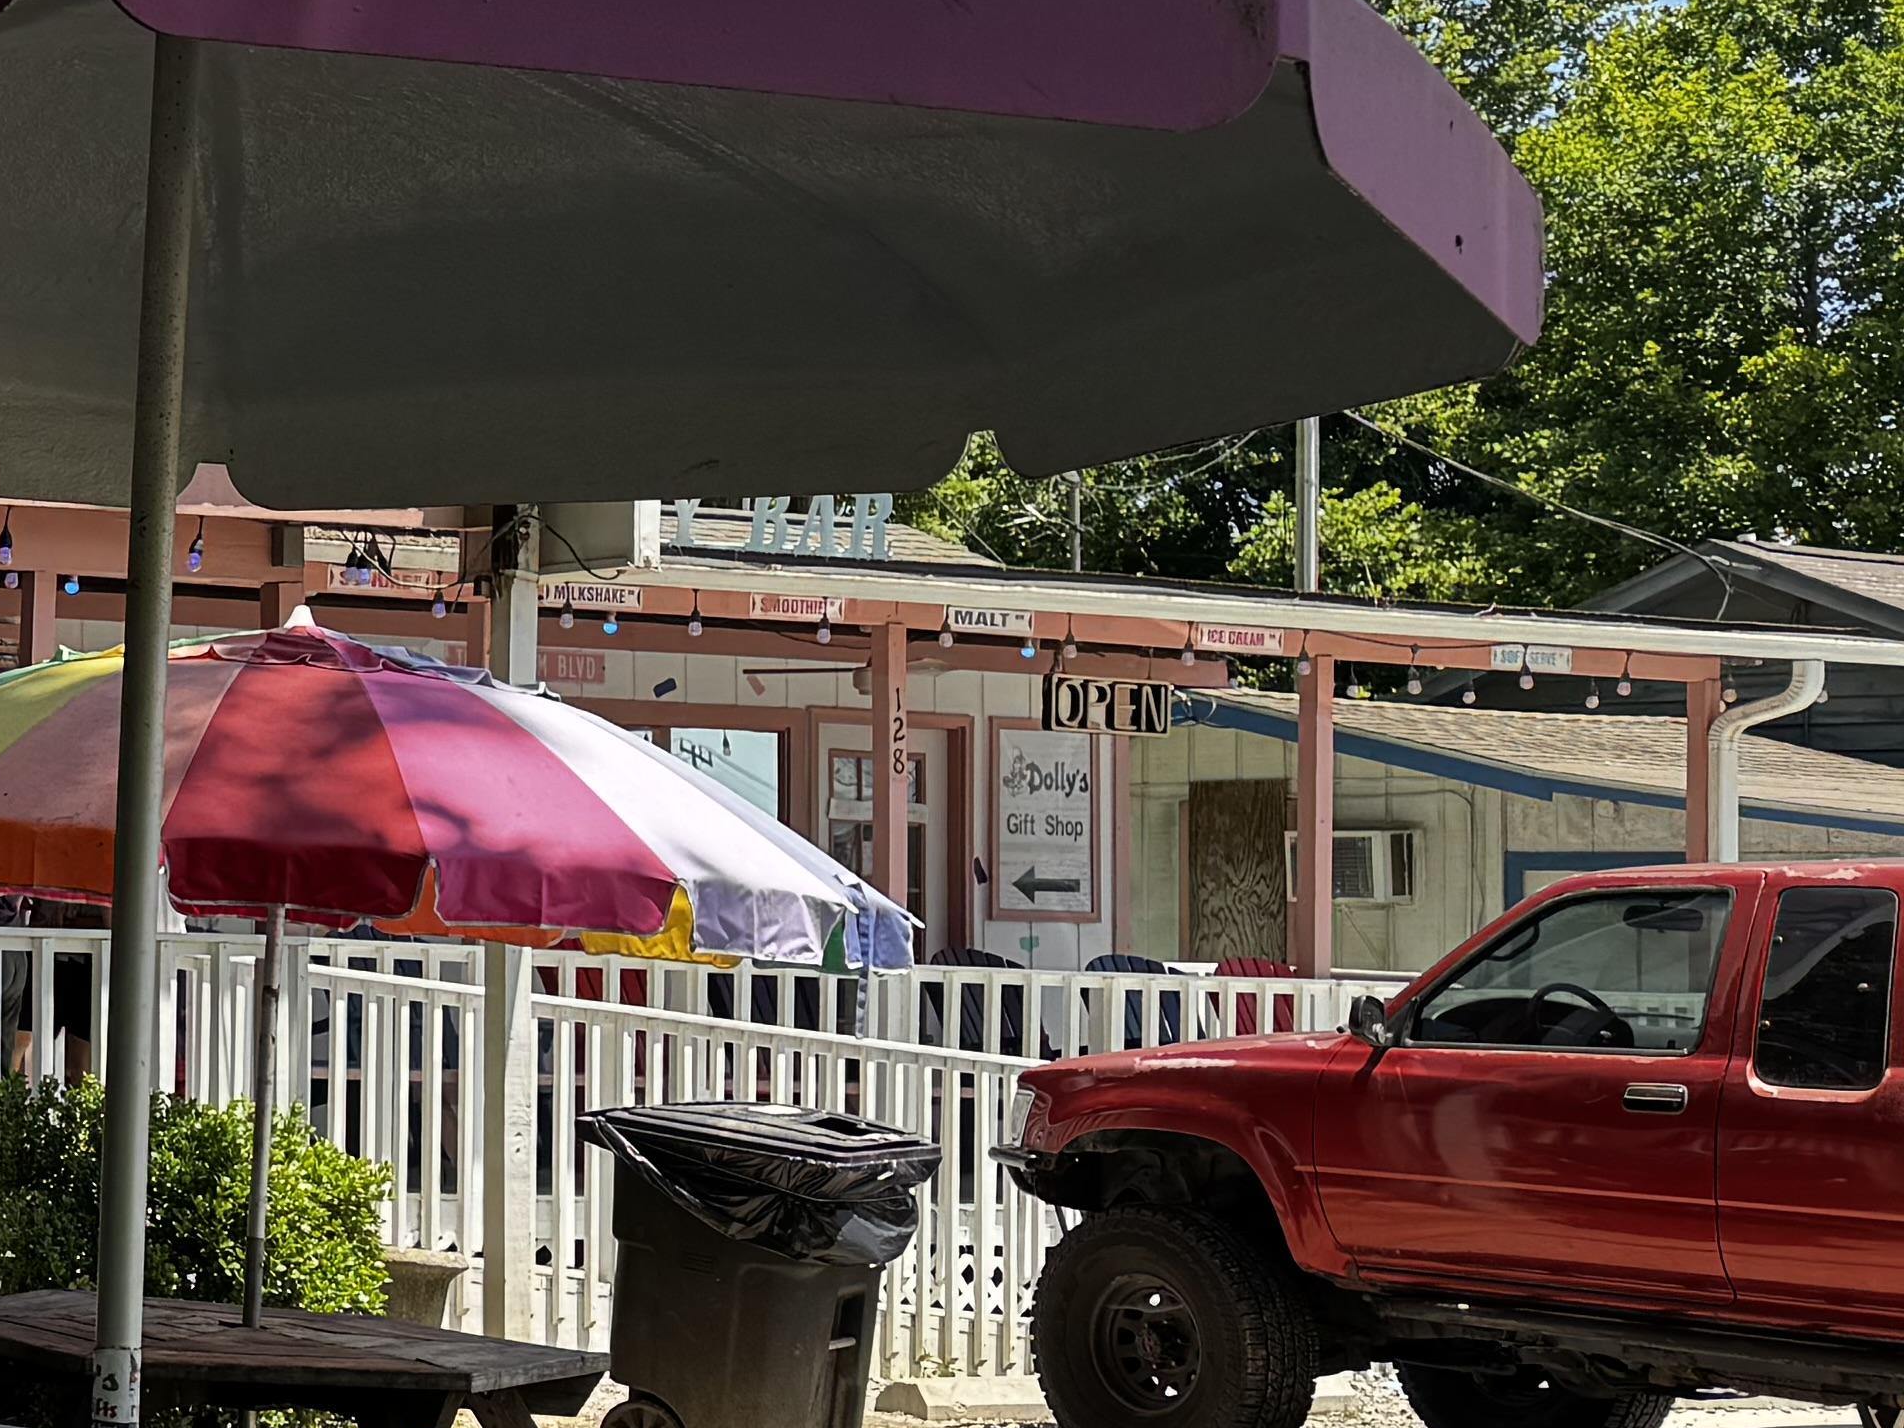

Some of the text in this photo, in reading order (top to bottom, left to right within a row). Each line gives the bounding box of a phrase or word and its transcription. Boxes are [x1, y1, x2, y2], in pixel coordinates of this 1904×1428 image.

[745, 493, 894, 561] BAR
[554, 585, 625, 603] MLKSHAKE
[954, 610, 1010, 627] MALT
[1208, 629, 1265, 646] ICE CREAM
[558, 654, 596, 679] BLVD
[1501, 650, 1525, 664] SOF
[1057, 679, 1166, 732] OPEN
[892, 687, 906, 774] 128
[1026, 761, 1089, 797] Dolly's
[1007, 813, 1084, 842] Gift Shop
